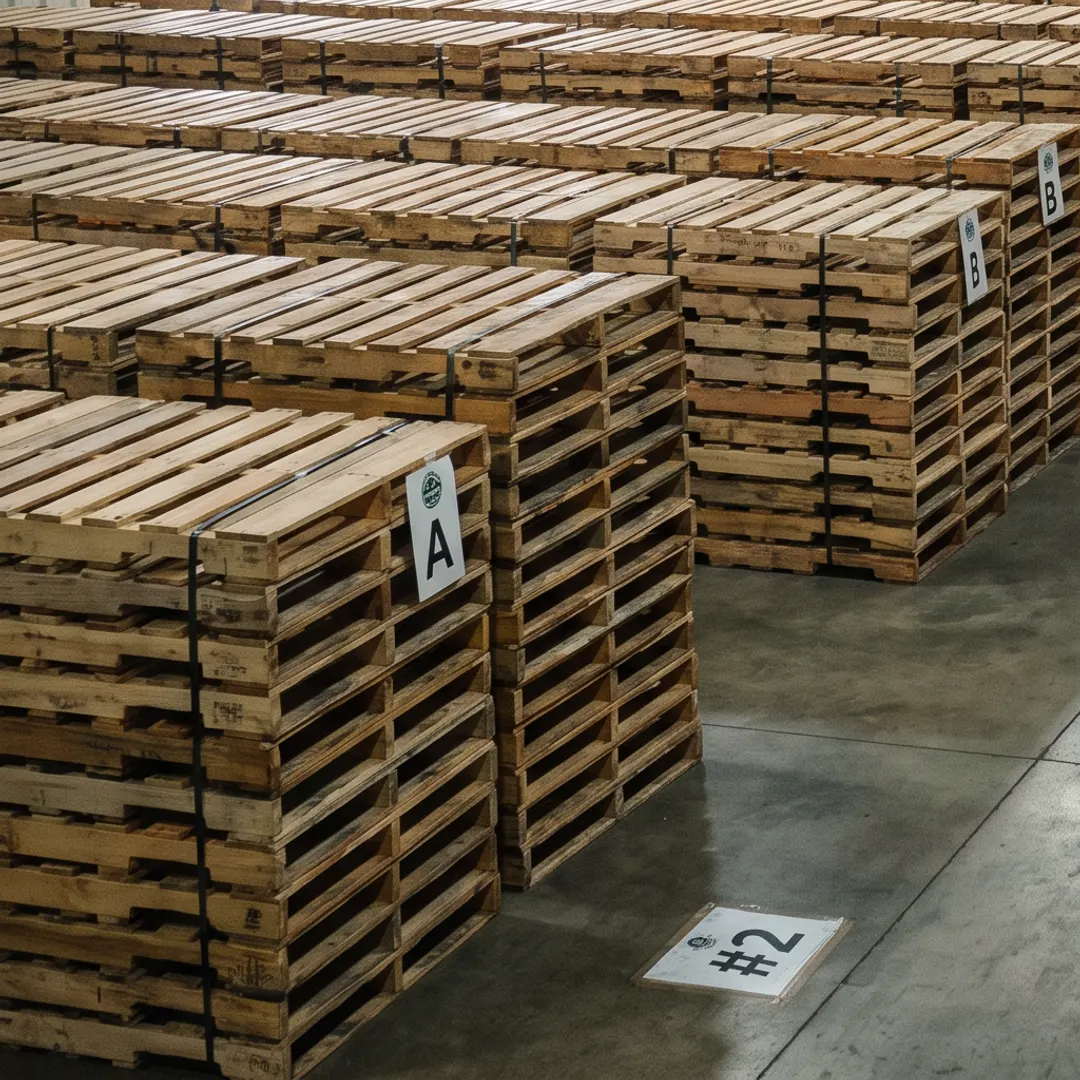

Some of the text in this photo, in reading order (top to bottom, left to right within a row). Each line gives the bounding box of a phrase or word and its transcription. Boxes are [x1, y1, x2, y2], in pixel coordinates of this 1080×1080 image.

[1044, 180, 1057, 216] B
[969, 251, 980, 289] B
[426, 517, 454, 581] A
[708, 928, 806, 978] #2
